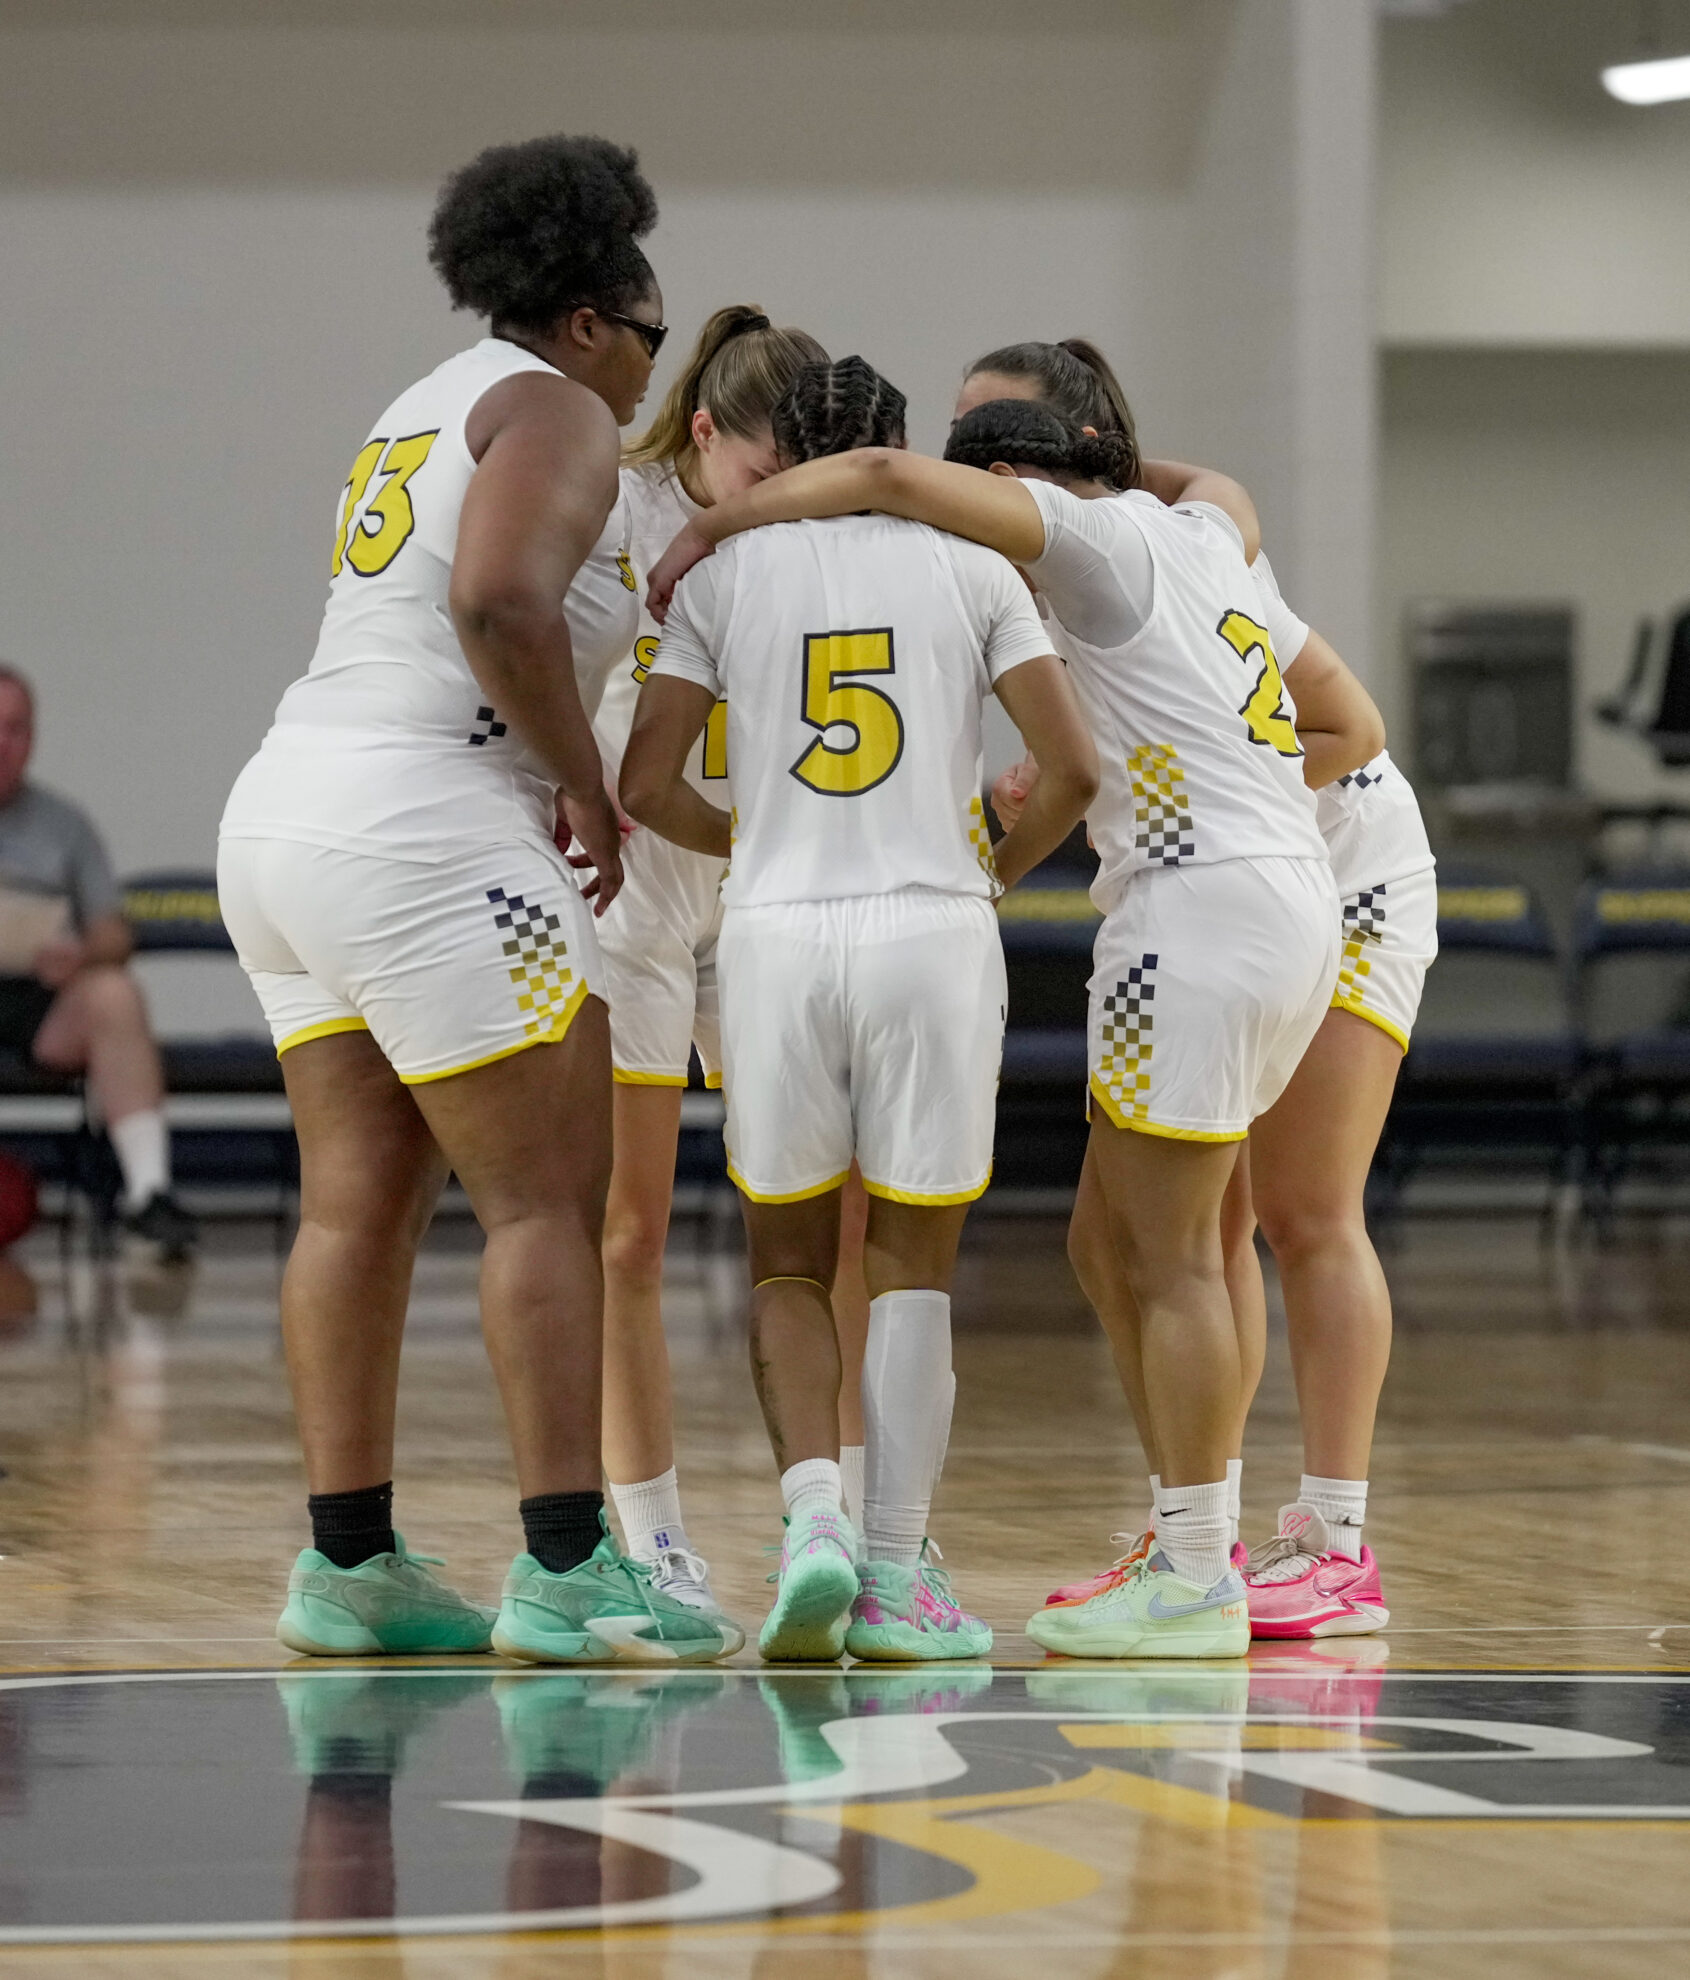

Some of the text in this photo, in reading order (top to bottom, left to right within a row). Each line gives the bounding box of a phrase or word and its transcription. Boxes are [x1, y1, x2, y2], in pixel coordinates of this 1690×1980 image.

[331, 428, 441, 578] 13
[788, 626, 905, 797] 5
[1216, 608, 1305, 758] 2
